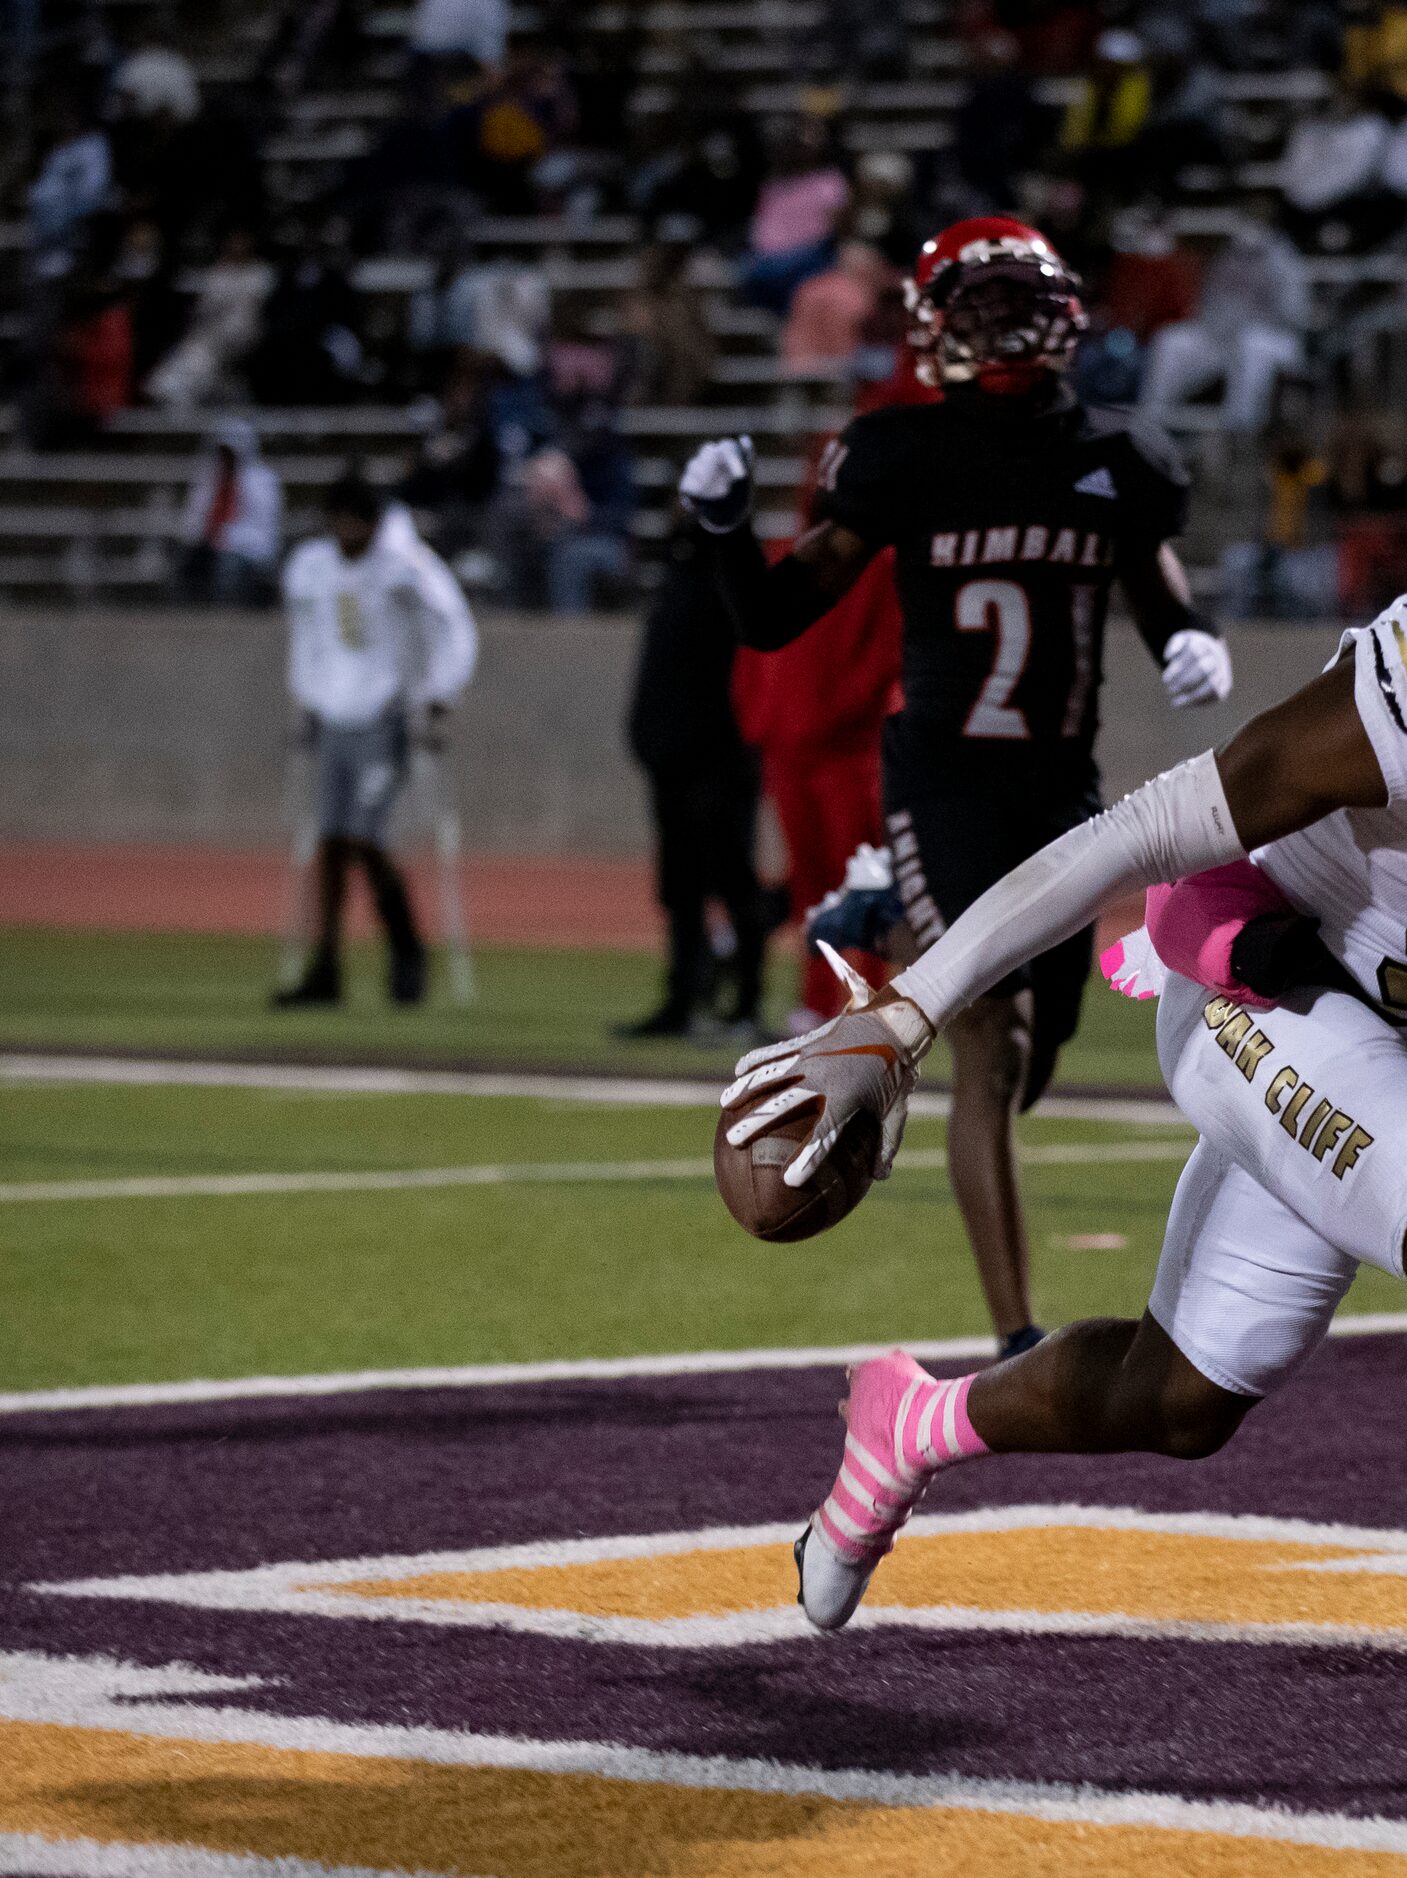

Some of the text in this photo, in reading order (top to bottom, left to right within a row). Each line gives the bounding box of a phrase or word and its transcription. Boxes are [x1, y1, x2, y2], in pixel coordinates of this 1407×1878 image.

[952, 576, 1097, 743] 21
[1203, 994, 1374, 1181] OAK CLIFF
